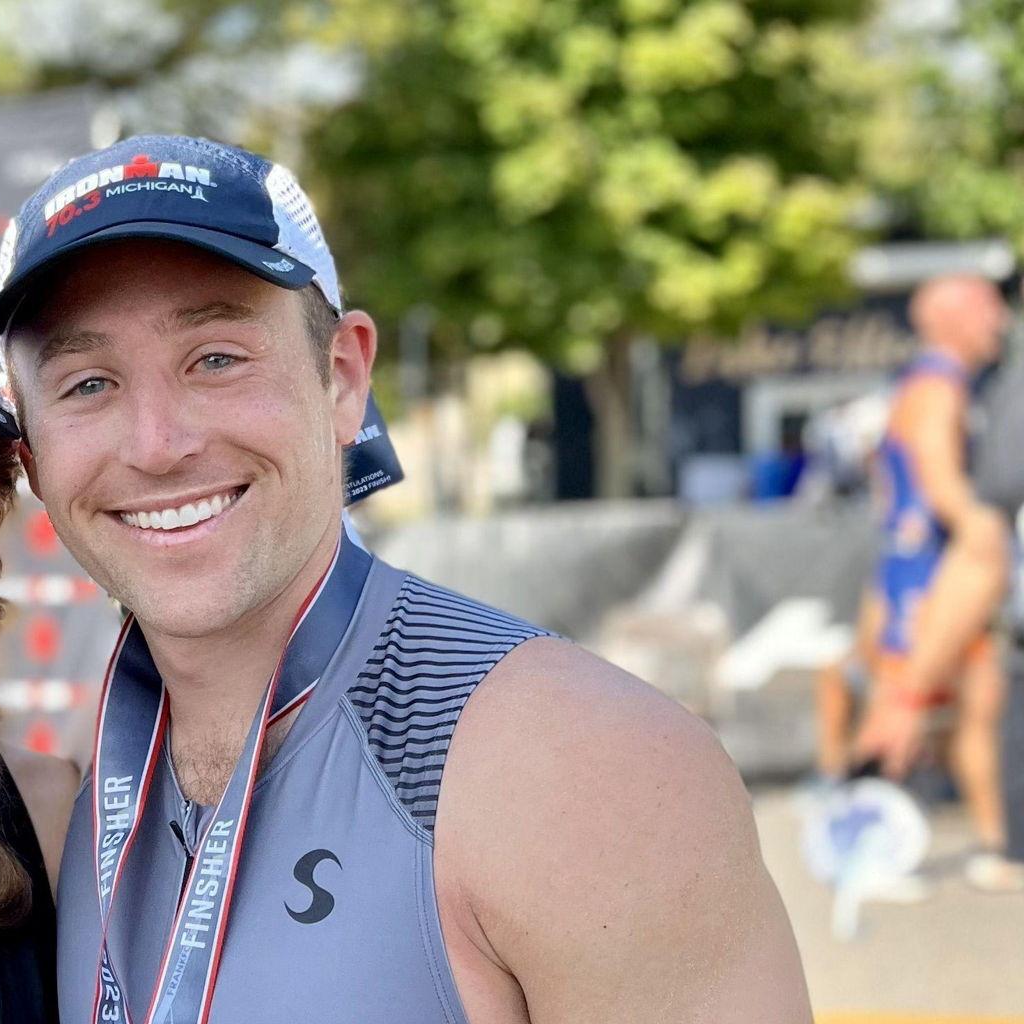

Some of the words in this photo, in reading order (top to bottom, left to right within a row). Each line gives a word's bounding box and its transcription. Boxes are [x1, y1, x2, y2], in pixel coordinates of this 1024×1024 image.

[44, 154, 214, 218] IRONMAN
[46, 191, 101, 238] 70.3
[105, 181, 193, 198] MICHIGAN
[180, 819, 235, 949] FINSHER
[102, 950, 120, 1022] 023
